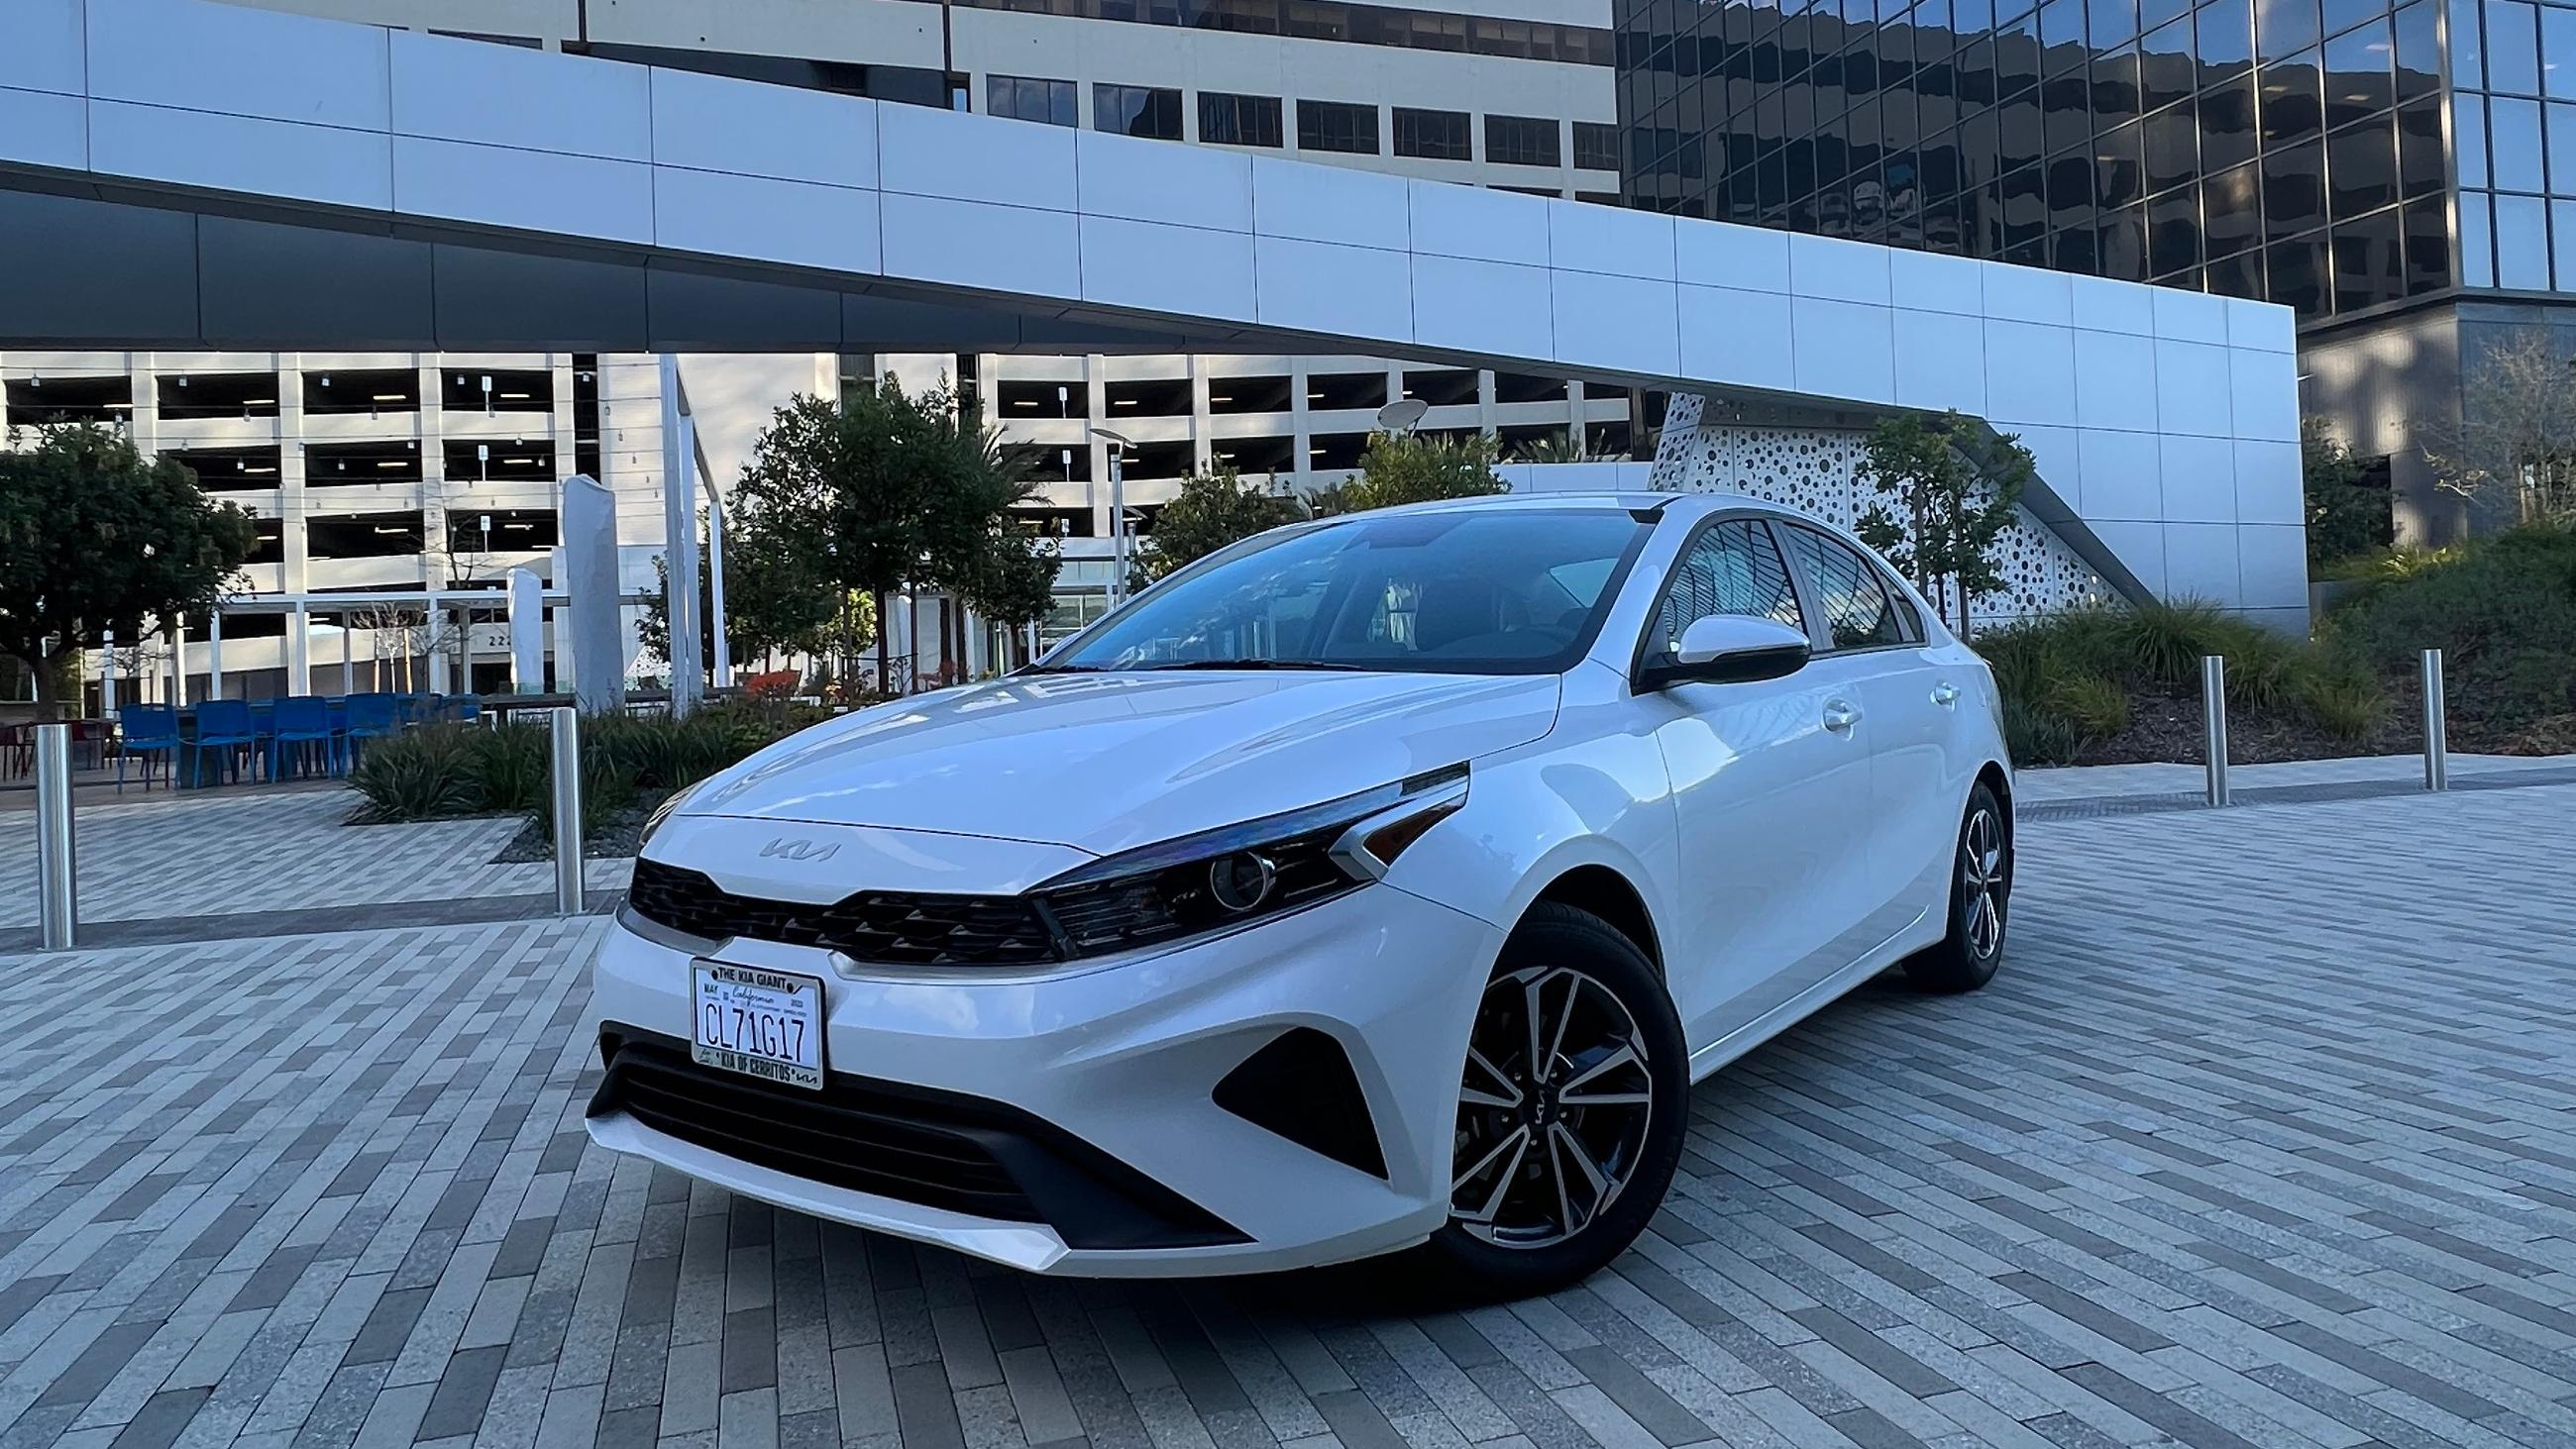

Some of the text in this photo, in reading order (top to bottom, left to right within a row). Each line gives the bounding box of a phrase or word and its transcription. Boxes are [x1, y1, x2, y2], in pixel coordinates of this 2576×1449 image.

[759, 838, 841, 863] KIA
[704, 983, 718, 993] MAY
[718, 968, 787, 989] THE KIA GIANT
[732, 985, 774, 1006] California
[705, 1003, 805, 1062] CL71G17
[721, 1052, 735, 1069] KIA
[738, 1056, 747, 1071] OF
[750, 1059, 790, 1082] CERRITOS
